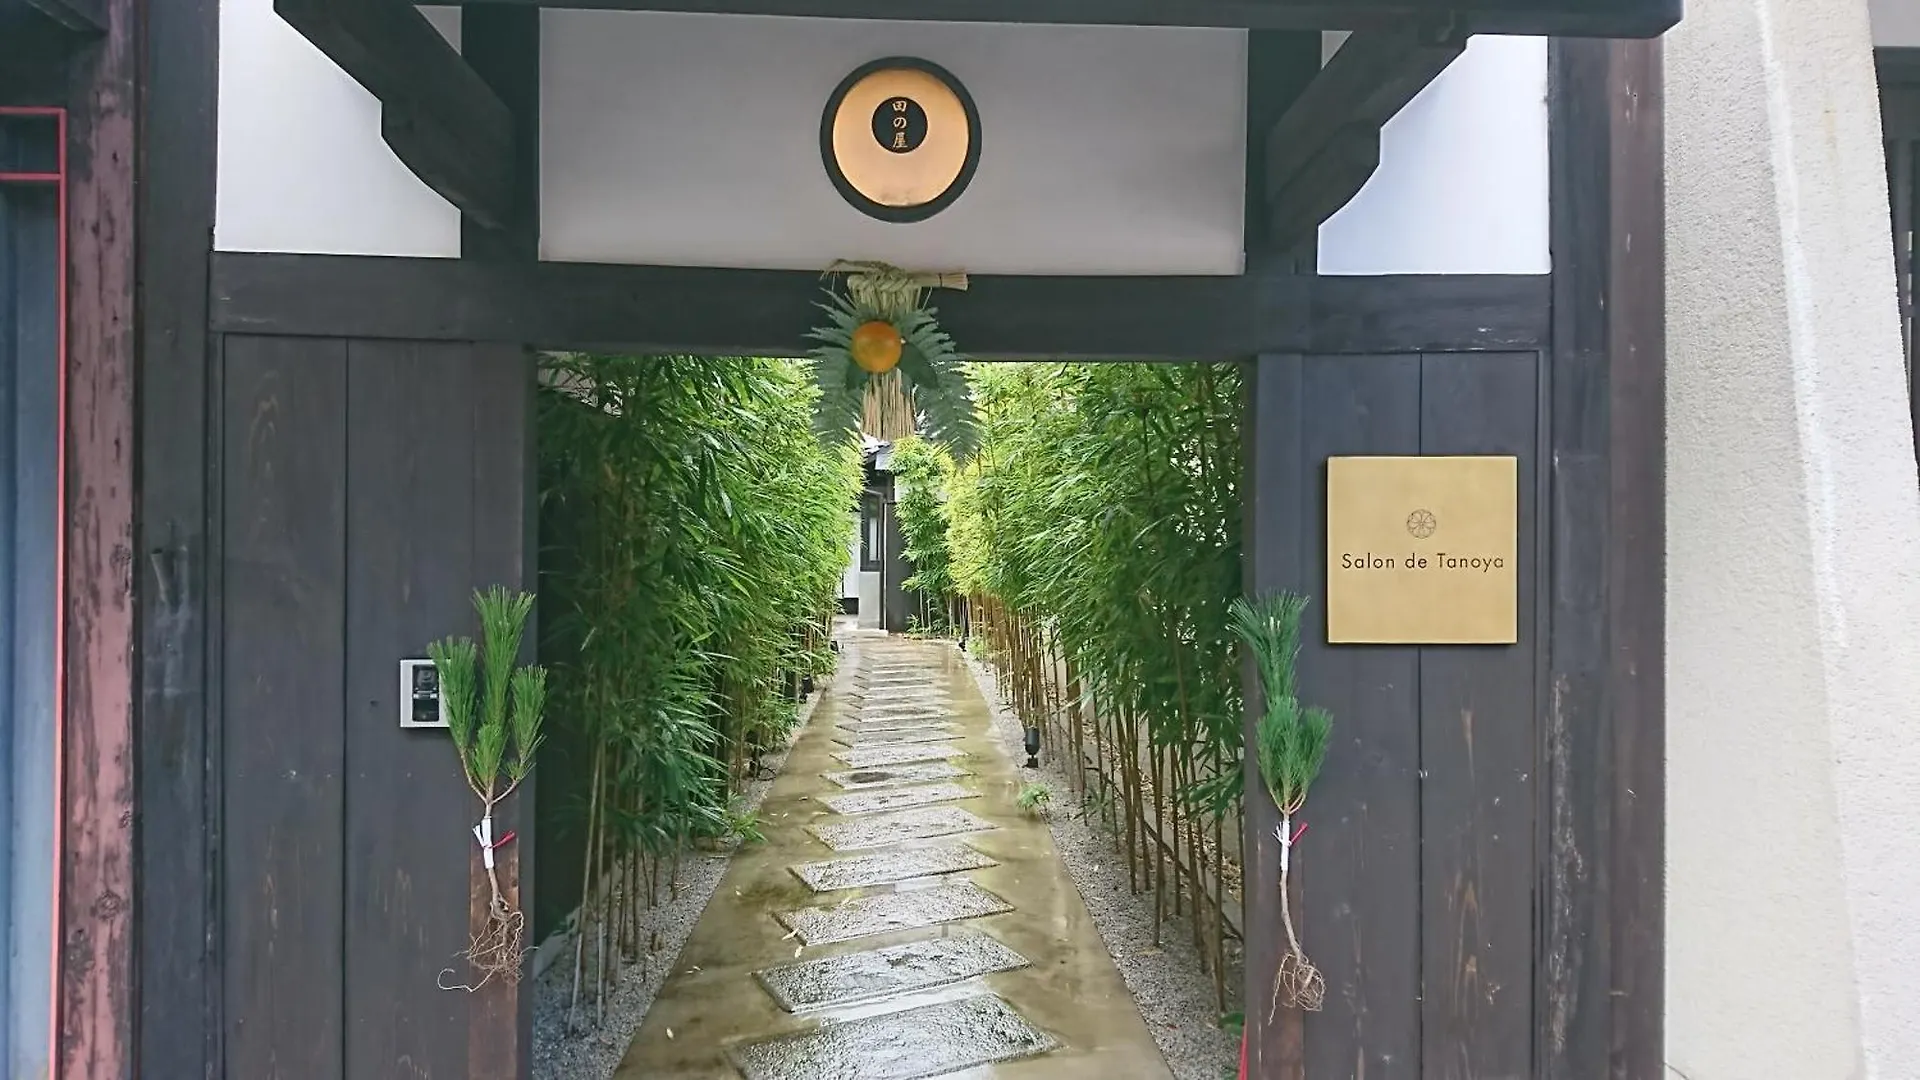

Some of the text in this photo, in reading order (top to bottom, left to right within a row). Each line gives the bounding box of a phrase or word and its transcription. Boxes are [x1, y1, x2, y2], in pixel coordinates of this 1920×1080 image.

[892, 100, 908, 148] 田の屋
[1341, 552, 1504, 573] Salon de Tanoya
